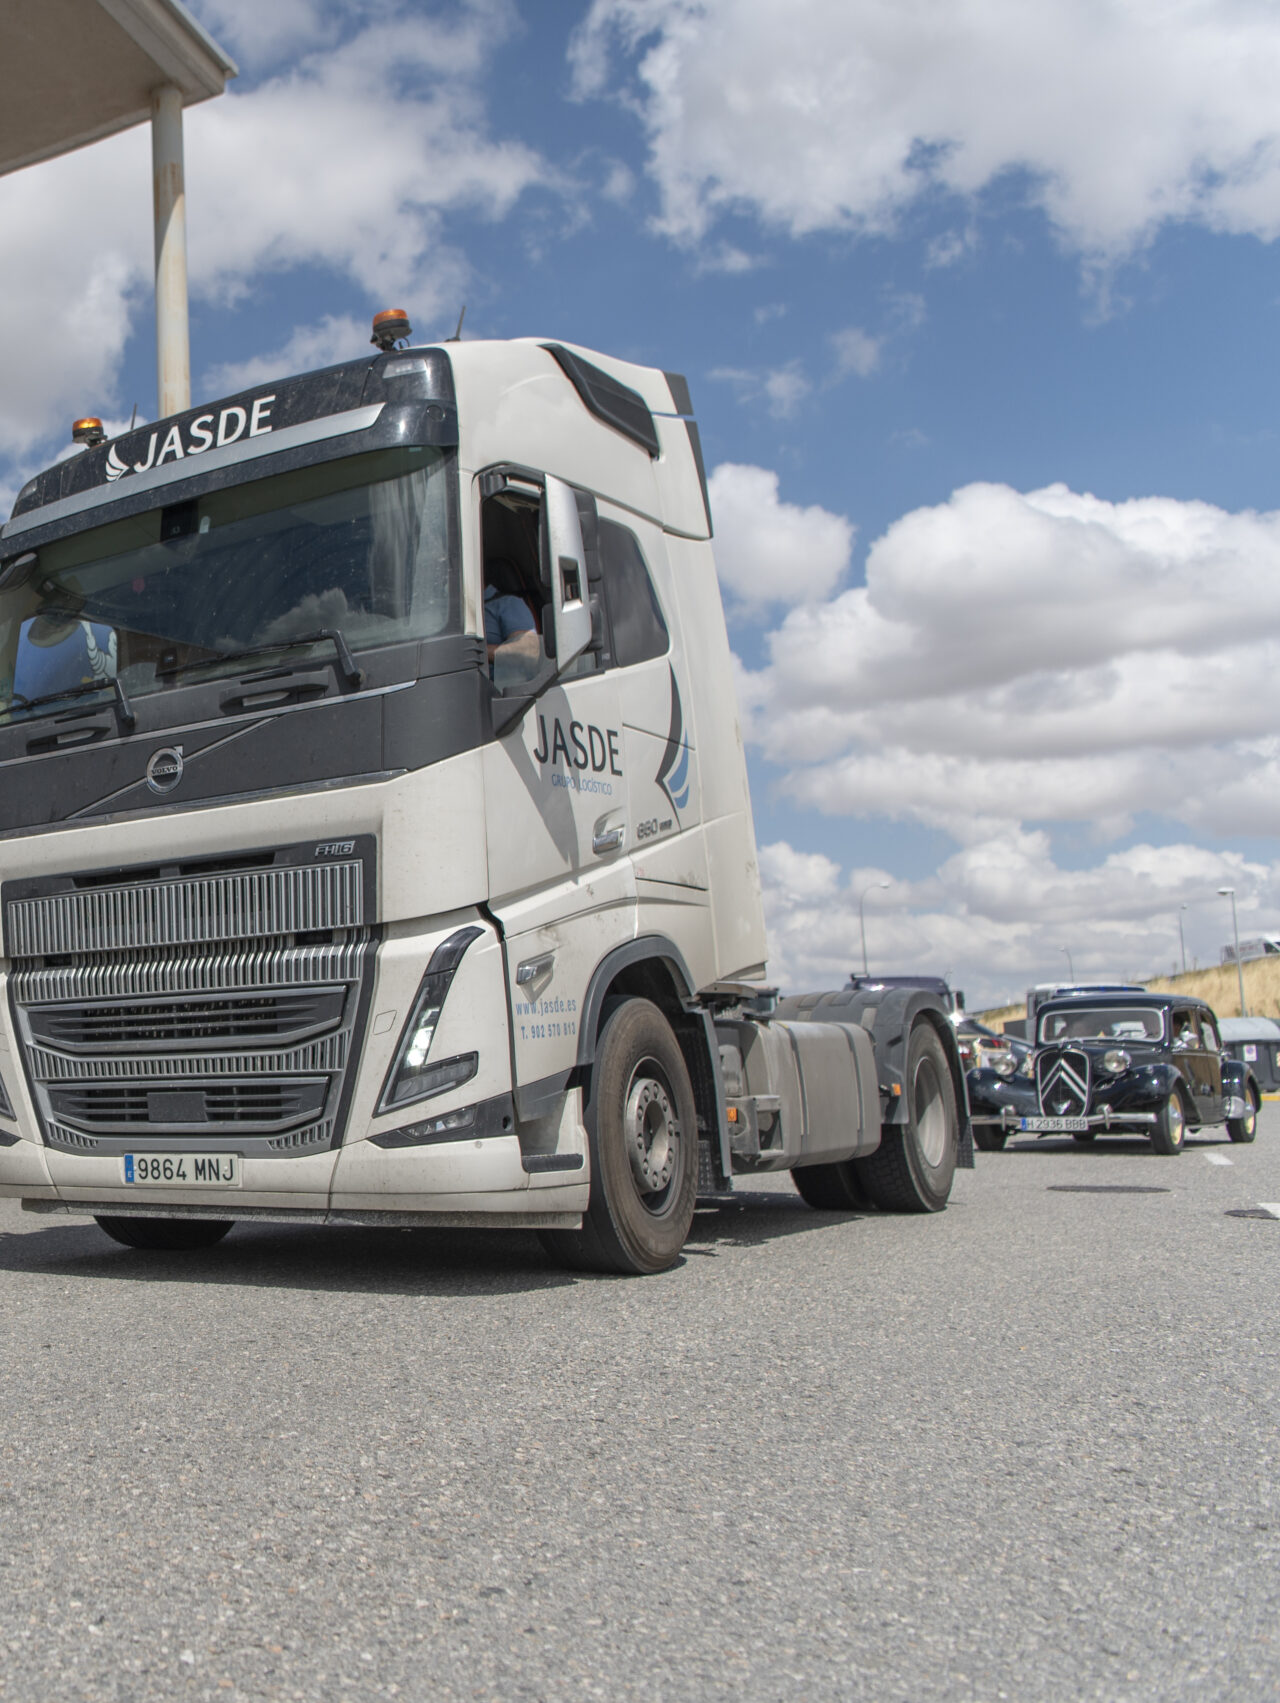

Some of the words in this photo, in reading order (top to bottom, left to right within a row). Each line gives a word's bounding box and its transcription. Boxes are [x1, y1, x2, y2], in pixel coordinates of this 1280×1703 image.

[133, 395, 276, 473] JASDE
[533, 714, 623, 777] JASDE
[151, 765, 178, 775] VOLVO
[551, 772, 576, 790] GRUPO
[314, 840, 355, 857] FH16
[516, 996, 577, 1016] www.jasde.es
[531, 1024, 545, 1039] 902
[548, 1023, 561, 1038] 570
[1065, 1119, 1086, 1130] BBB
[138, 1158, 187, 1181] 9864
[194, 1158, 233, 1181] MNJ
